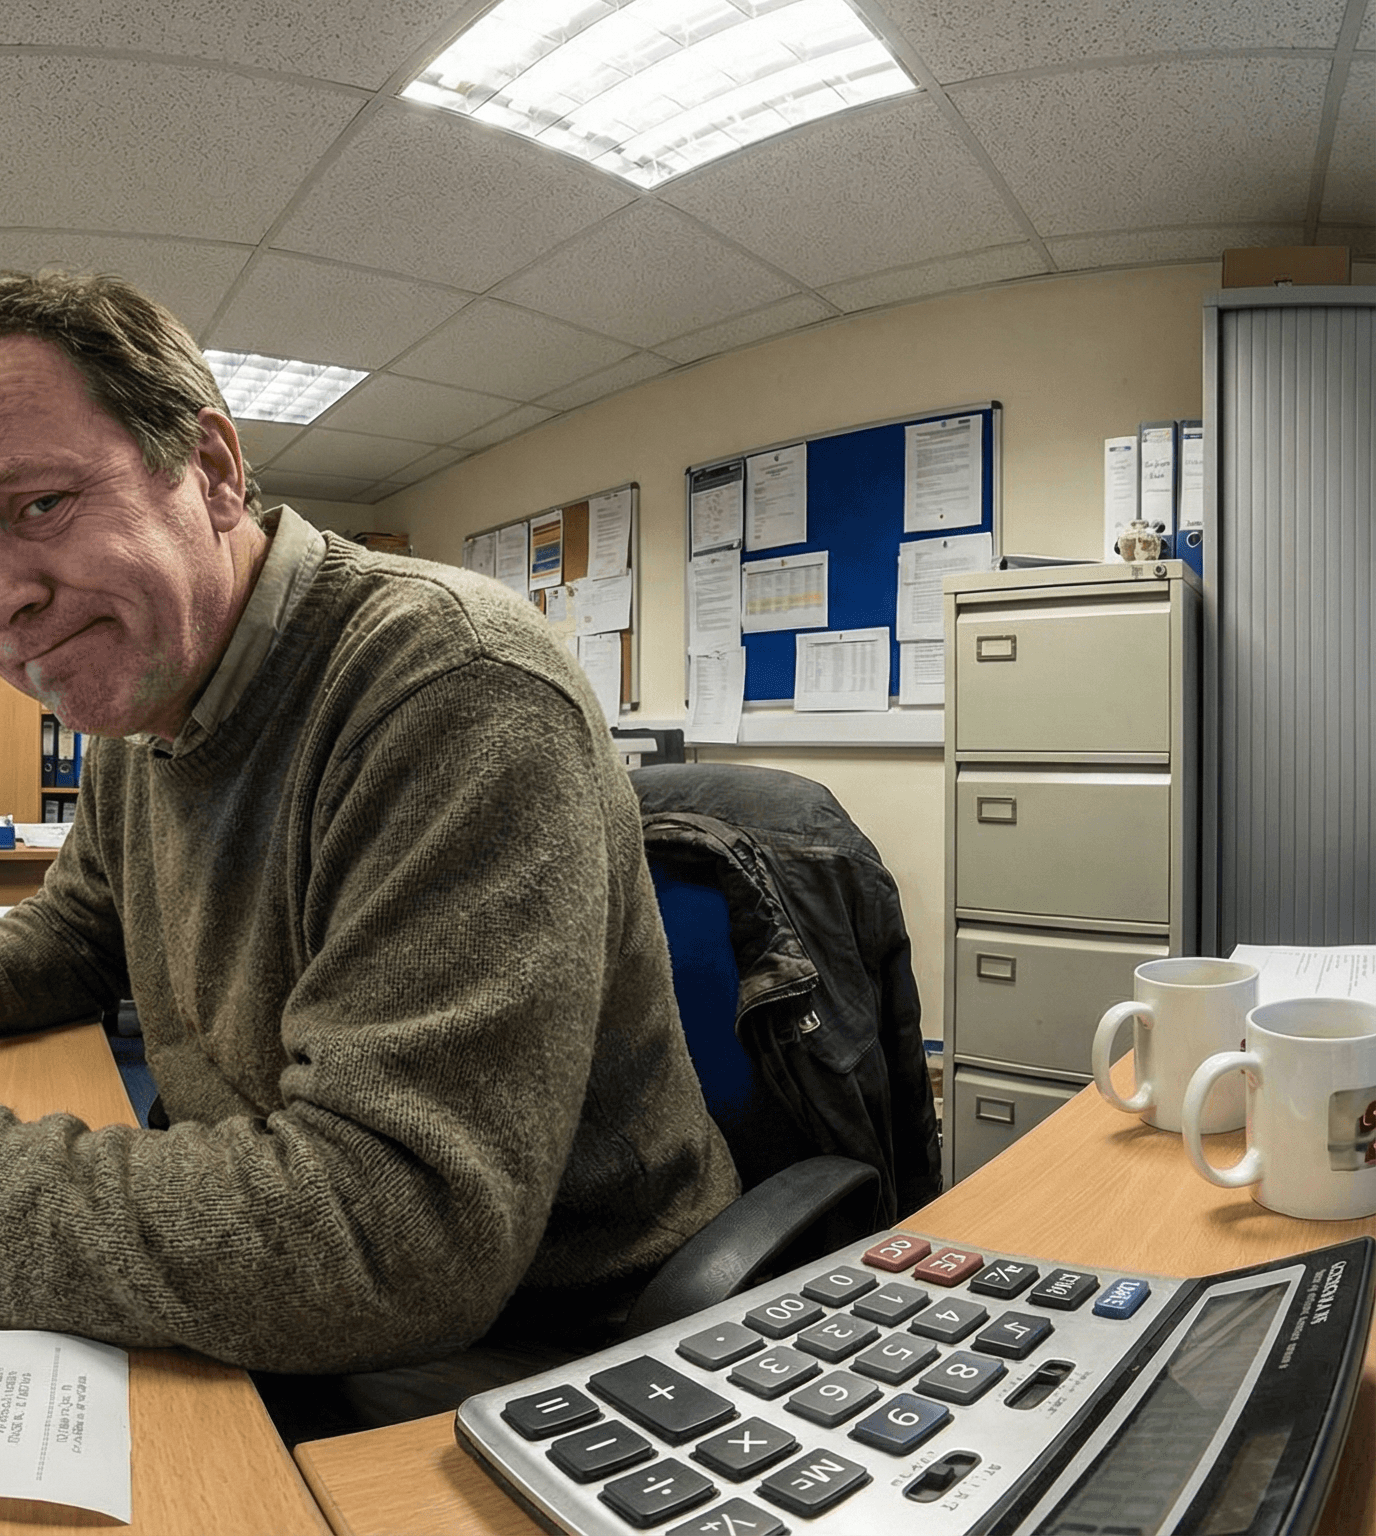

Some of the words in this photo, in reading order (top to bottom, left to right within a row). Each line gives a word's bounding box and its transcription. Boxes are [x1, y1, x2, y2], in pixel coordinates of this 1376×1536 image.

[878, 1293, 904, 1304] 1
[935, 1309, 962, 1324] 4
[881, 1343, 914, 1361] 5
[945, 1362, 979, 1379] 8
[818, 1384, 849, 1402] 6
